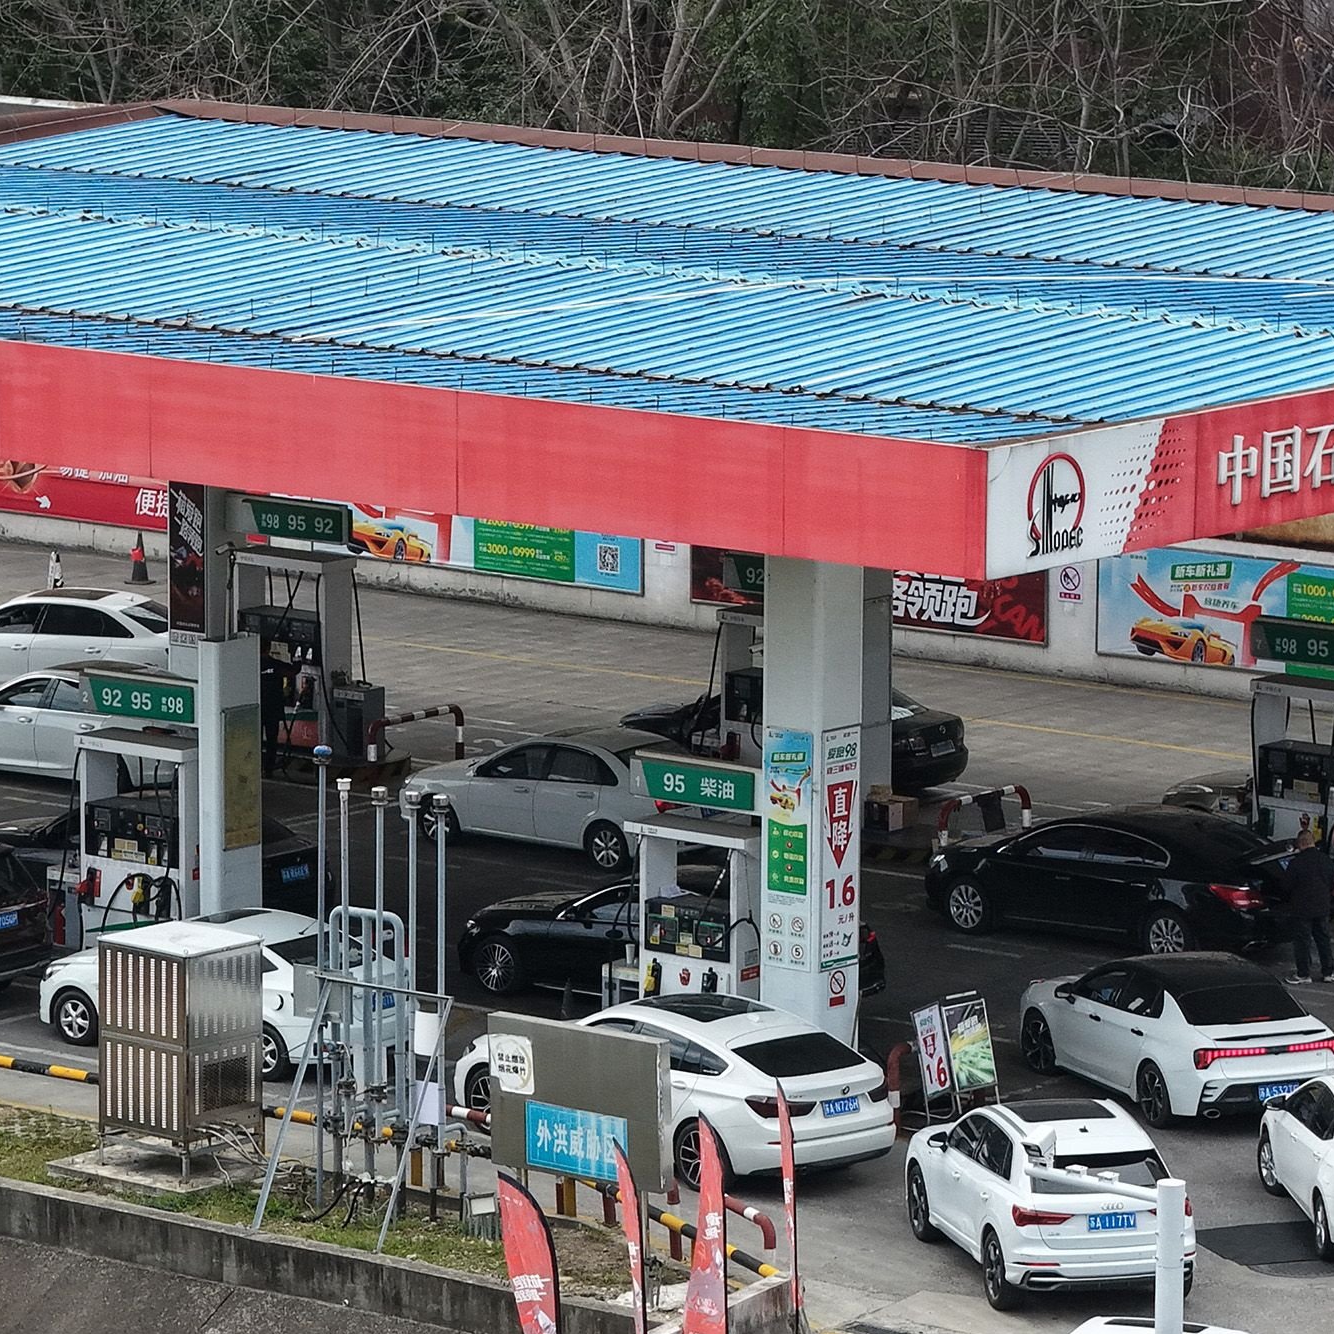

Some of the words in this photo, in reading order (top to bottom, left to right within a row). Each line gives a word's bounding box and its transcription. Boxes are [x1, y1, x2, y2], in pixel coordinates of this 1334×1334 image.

[288, 515, 306, 531] 95
[314, 517, 333, 533] 92
[746, 567, 764, 585] 92
[1307, 638, 1329, 657] 95
[102, 688, 122, 708] 92
[131, 691, 152, 711] 95
[664, 773, 685, 794] 95
[700, 778, 736, 802] 柴油
[832, 787, 848, 852] 直降
[825, 875, 855, 909] 1.6
[926, 1056, 948, 1088] 1.6
[536, 1118, 618, 1164] 外洪威胁区
